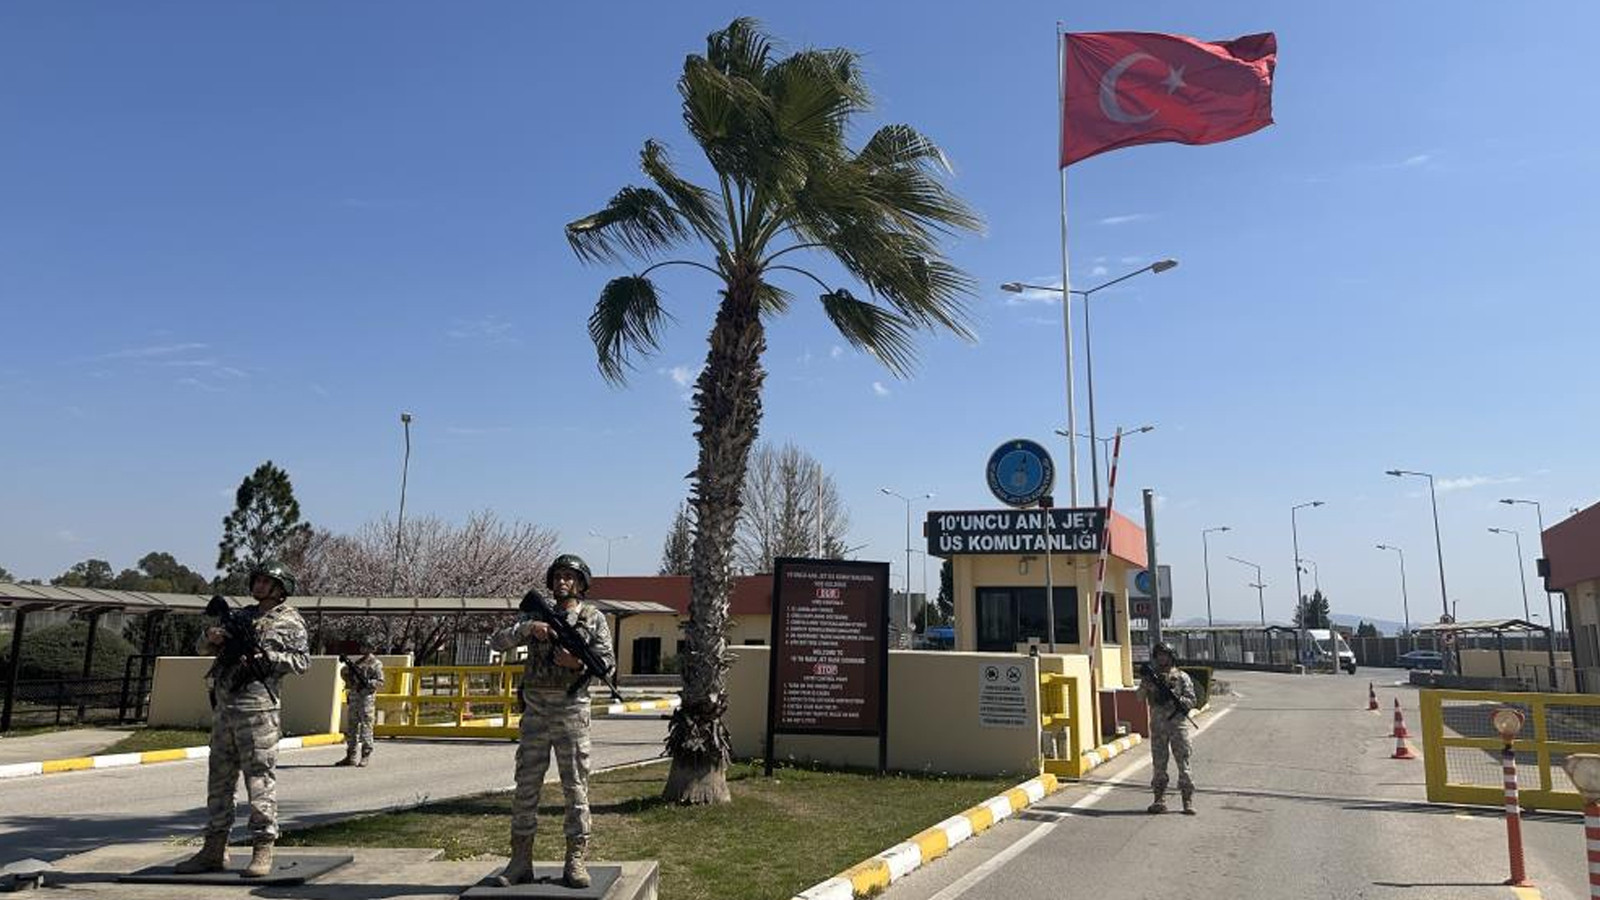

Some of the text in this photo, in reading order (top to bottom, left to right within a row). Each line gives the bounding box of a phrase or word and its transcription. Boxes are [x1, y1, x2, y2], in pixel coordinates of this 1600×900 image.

[938, 512, 1097, 531] 10'UNCU ANA JET
[939, 530, 1097, 551] ÜS KOMUTANLIĞI
